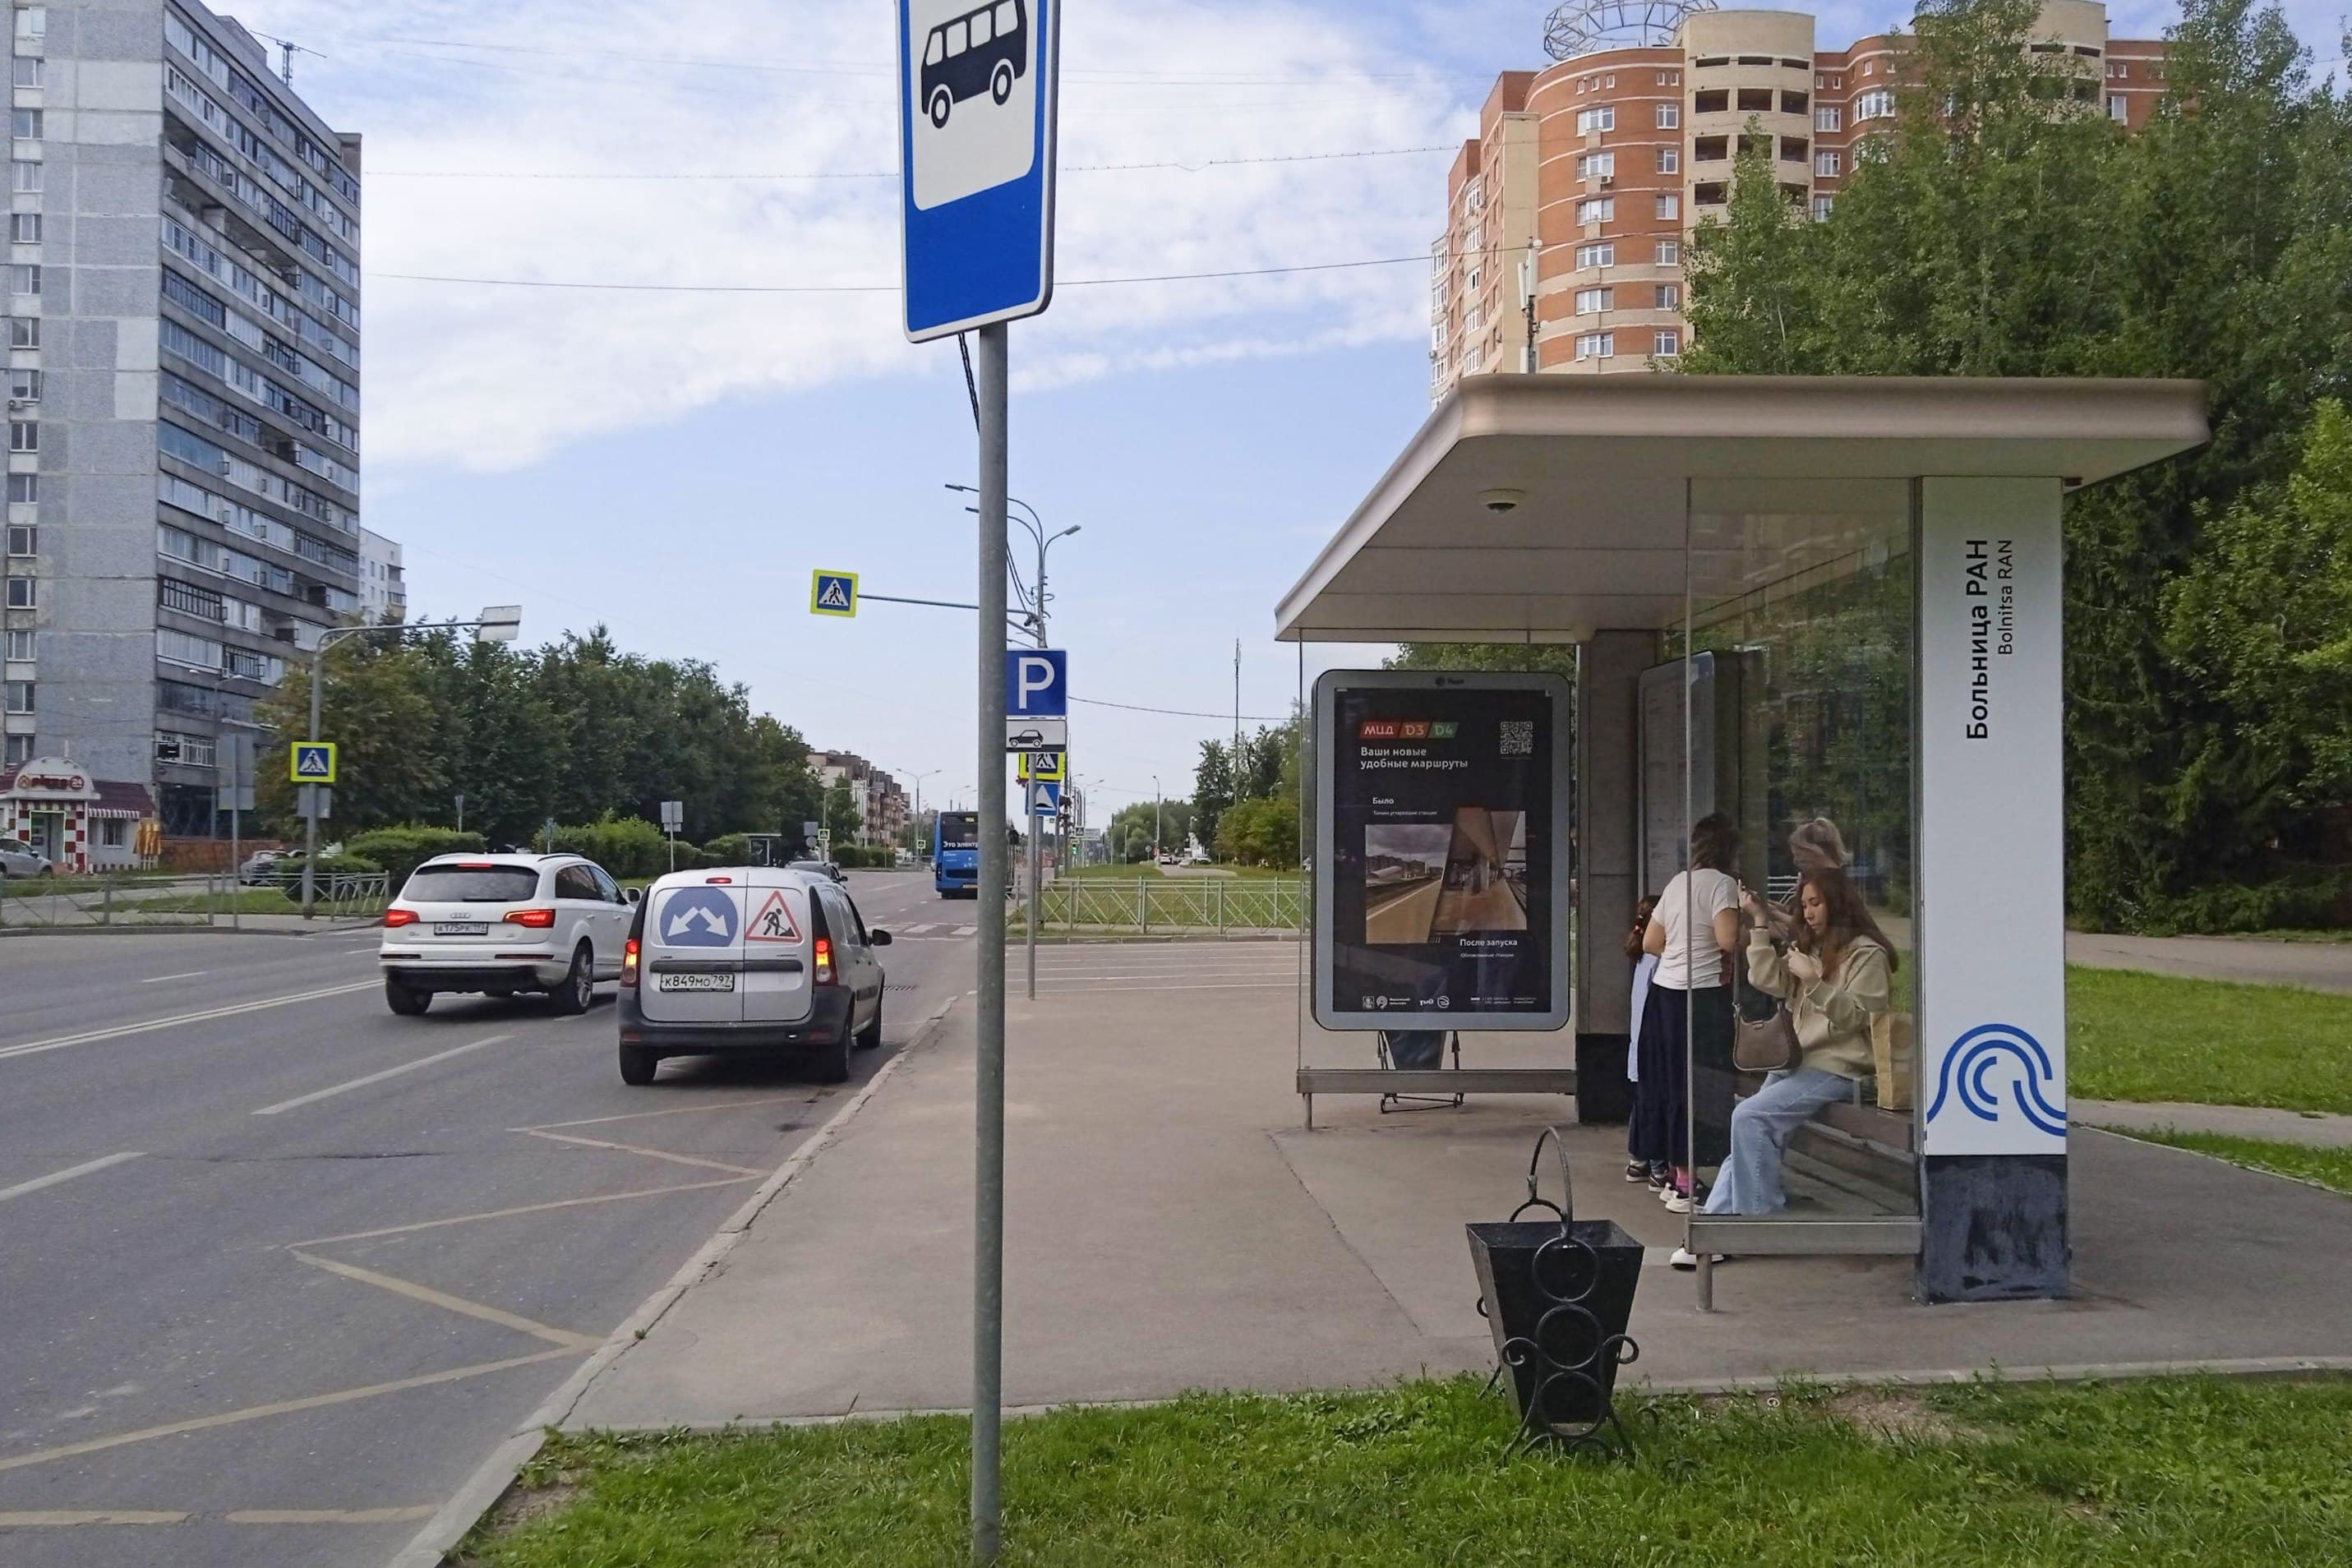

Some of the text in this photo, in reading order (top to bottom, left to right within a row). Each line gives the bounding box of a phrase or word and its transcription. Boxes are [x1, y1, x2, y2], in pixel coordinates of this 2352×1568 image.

[1998, 540, 2013, 655] Bolnitsa RAN
[1967, 540, 1990, 739] Больница РАН
[1017, 656, 1055, 710] P
[1364, 725, 1453, 736] МЦД D3 D4
[1361, 747, 1390, 756] Ваши
[1361, 759, 1468, 770] удобные маршруты
[1372, 796, 1395, 805] Было
[1460, 938, 1518, 948] После запуска
